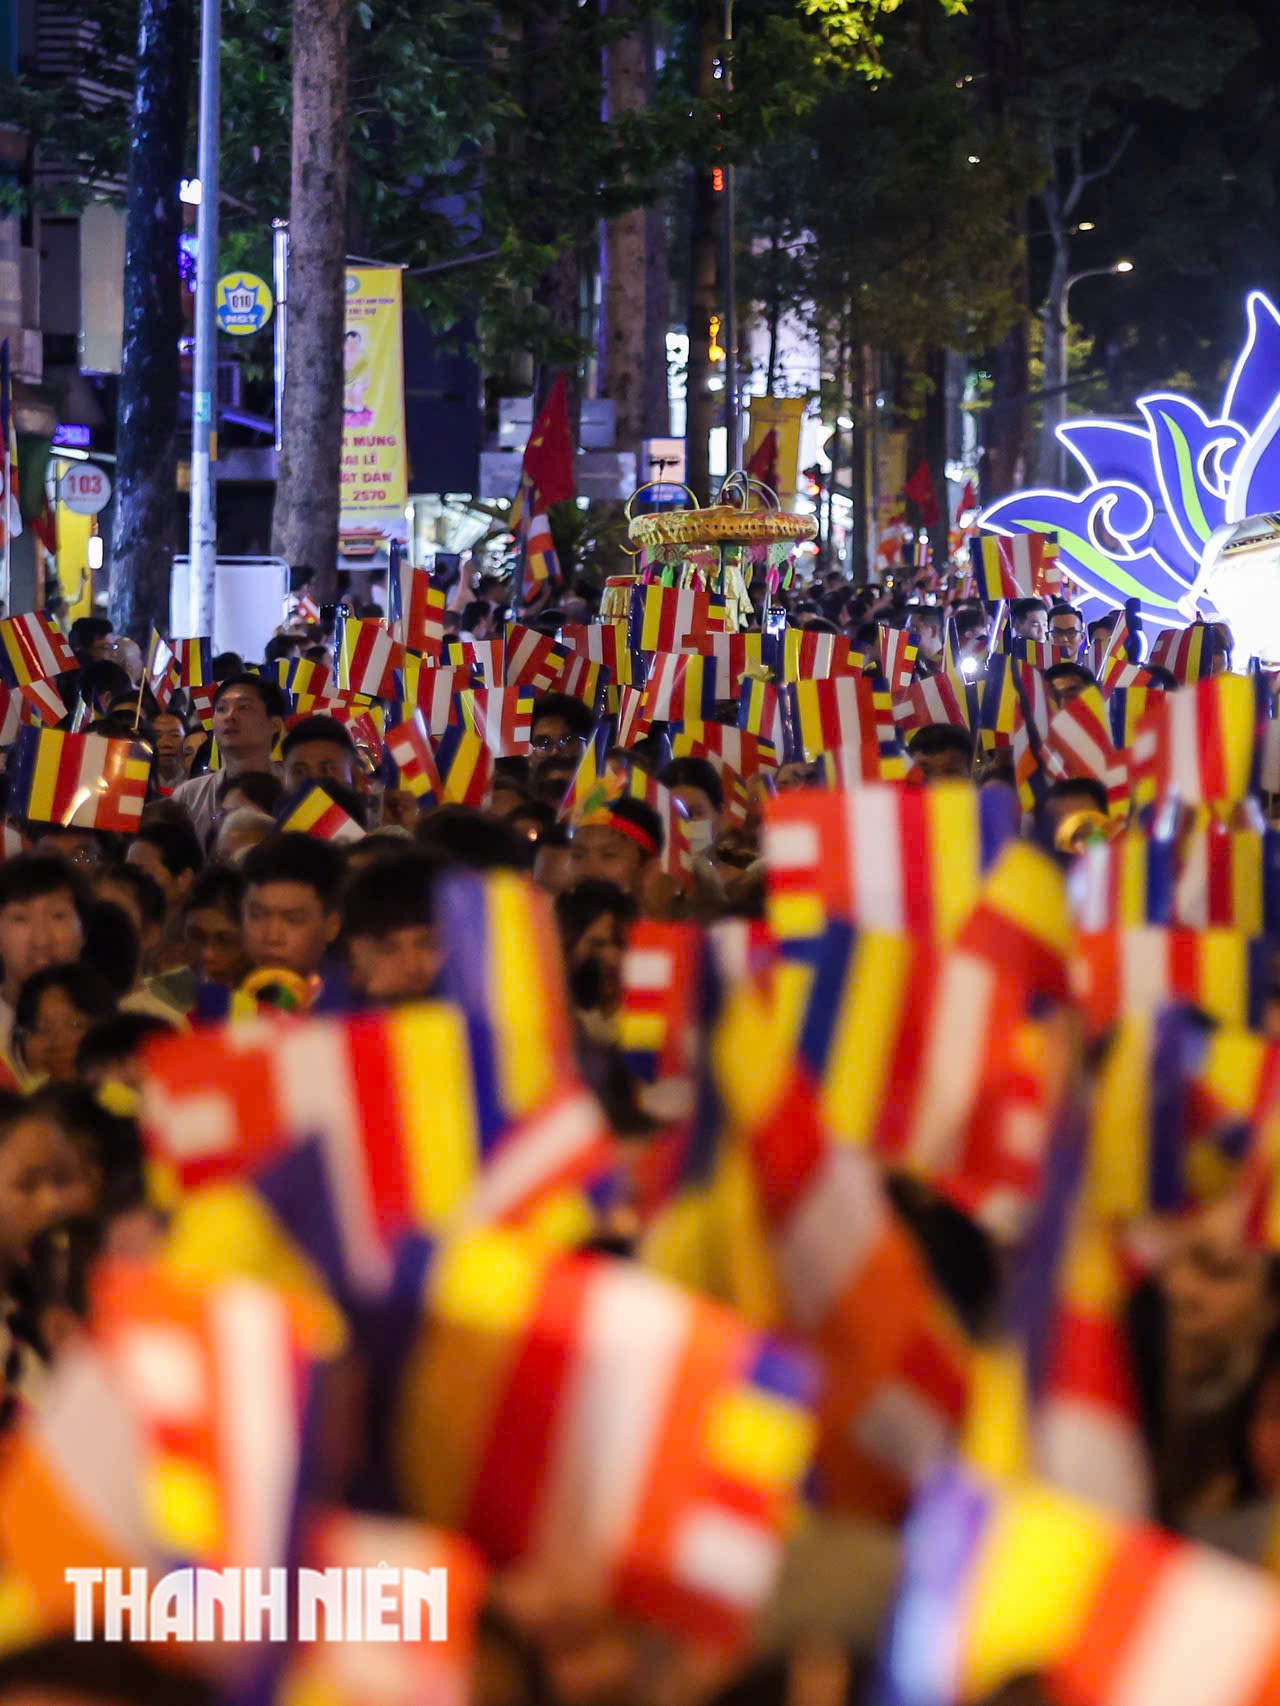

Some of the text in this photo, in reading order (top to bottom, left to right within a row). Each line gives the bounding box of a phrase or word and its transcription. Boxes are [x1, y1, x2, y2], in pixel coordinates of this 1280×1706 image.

[232, 295, 252, 308] 010
[68, 475, 102, 494] 103
[353, 490, 387, 501] 2570
